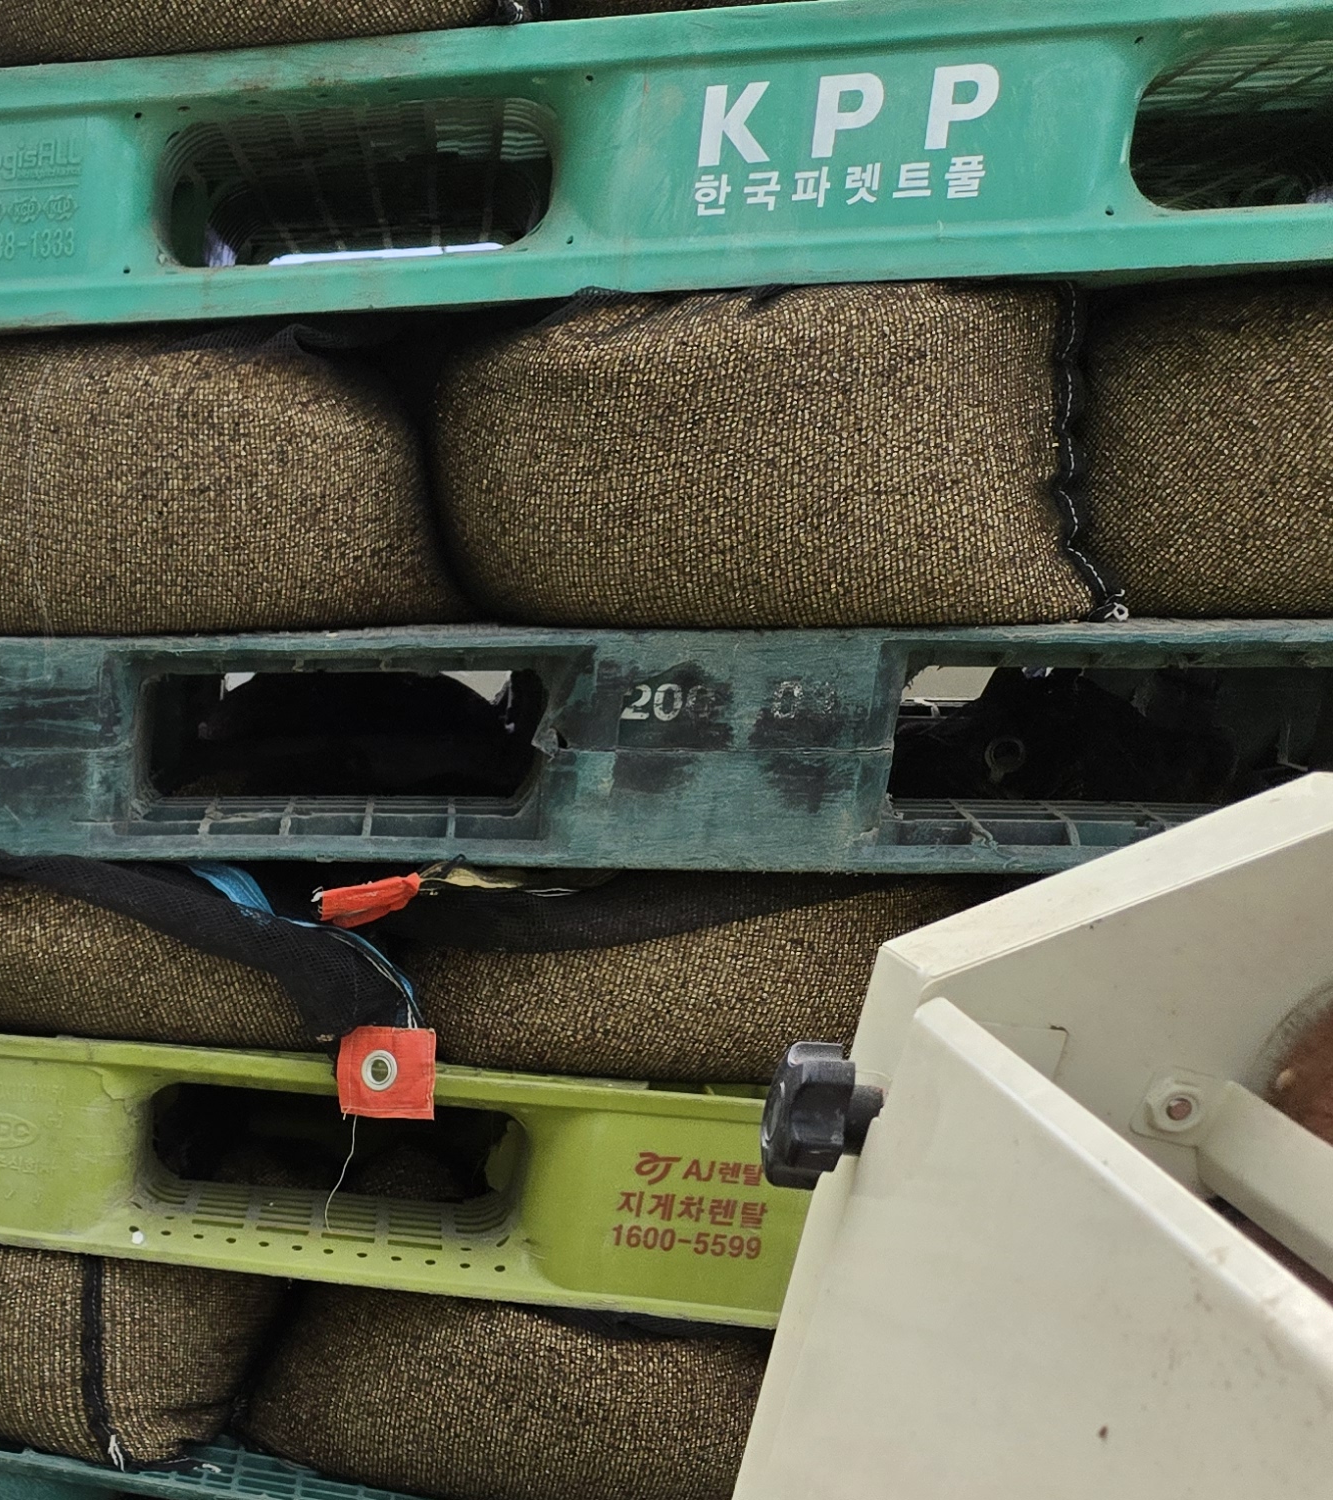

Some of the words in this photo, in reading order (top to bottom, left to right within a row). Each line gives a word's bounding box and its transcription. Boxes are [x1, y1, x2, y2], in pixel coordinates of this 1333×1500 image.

[694, 155, 986, 216] 한국파렛트풀
[616, 1191, 768, 1229] 지게차렌탈
[612, 1224, 762, 1260] 1600-5599
